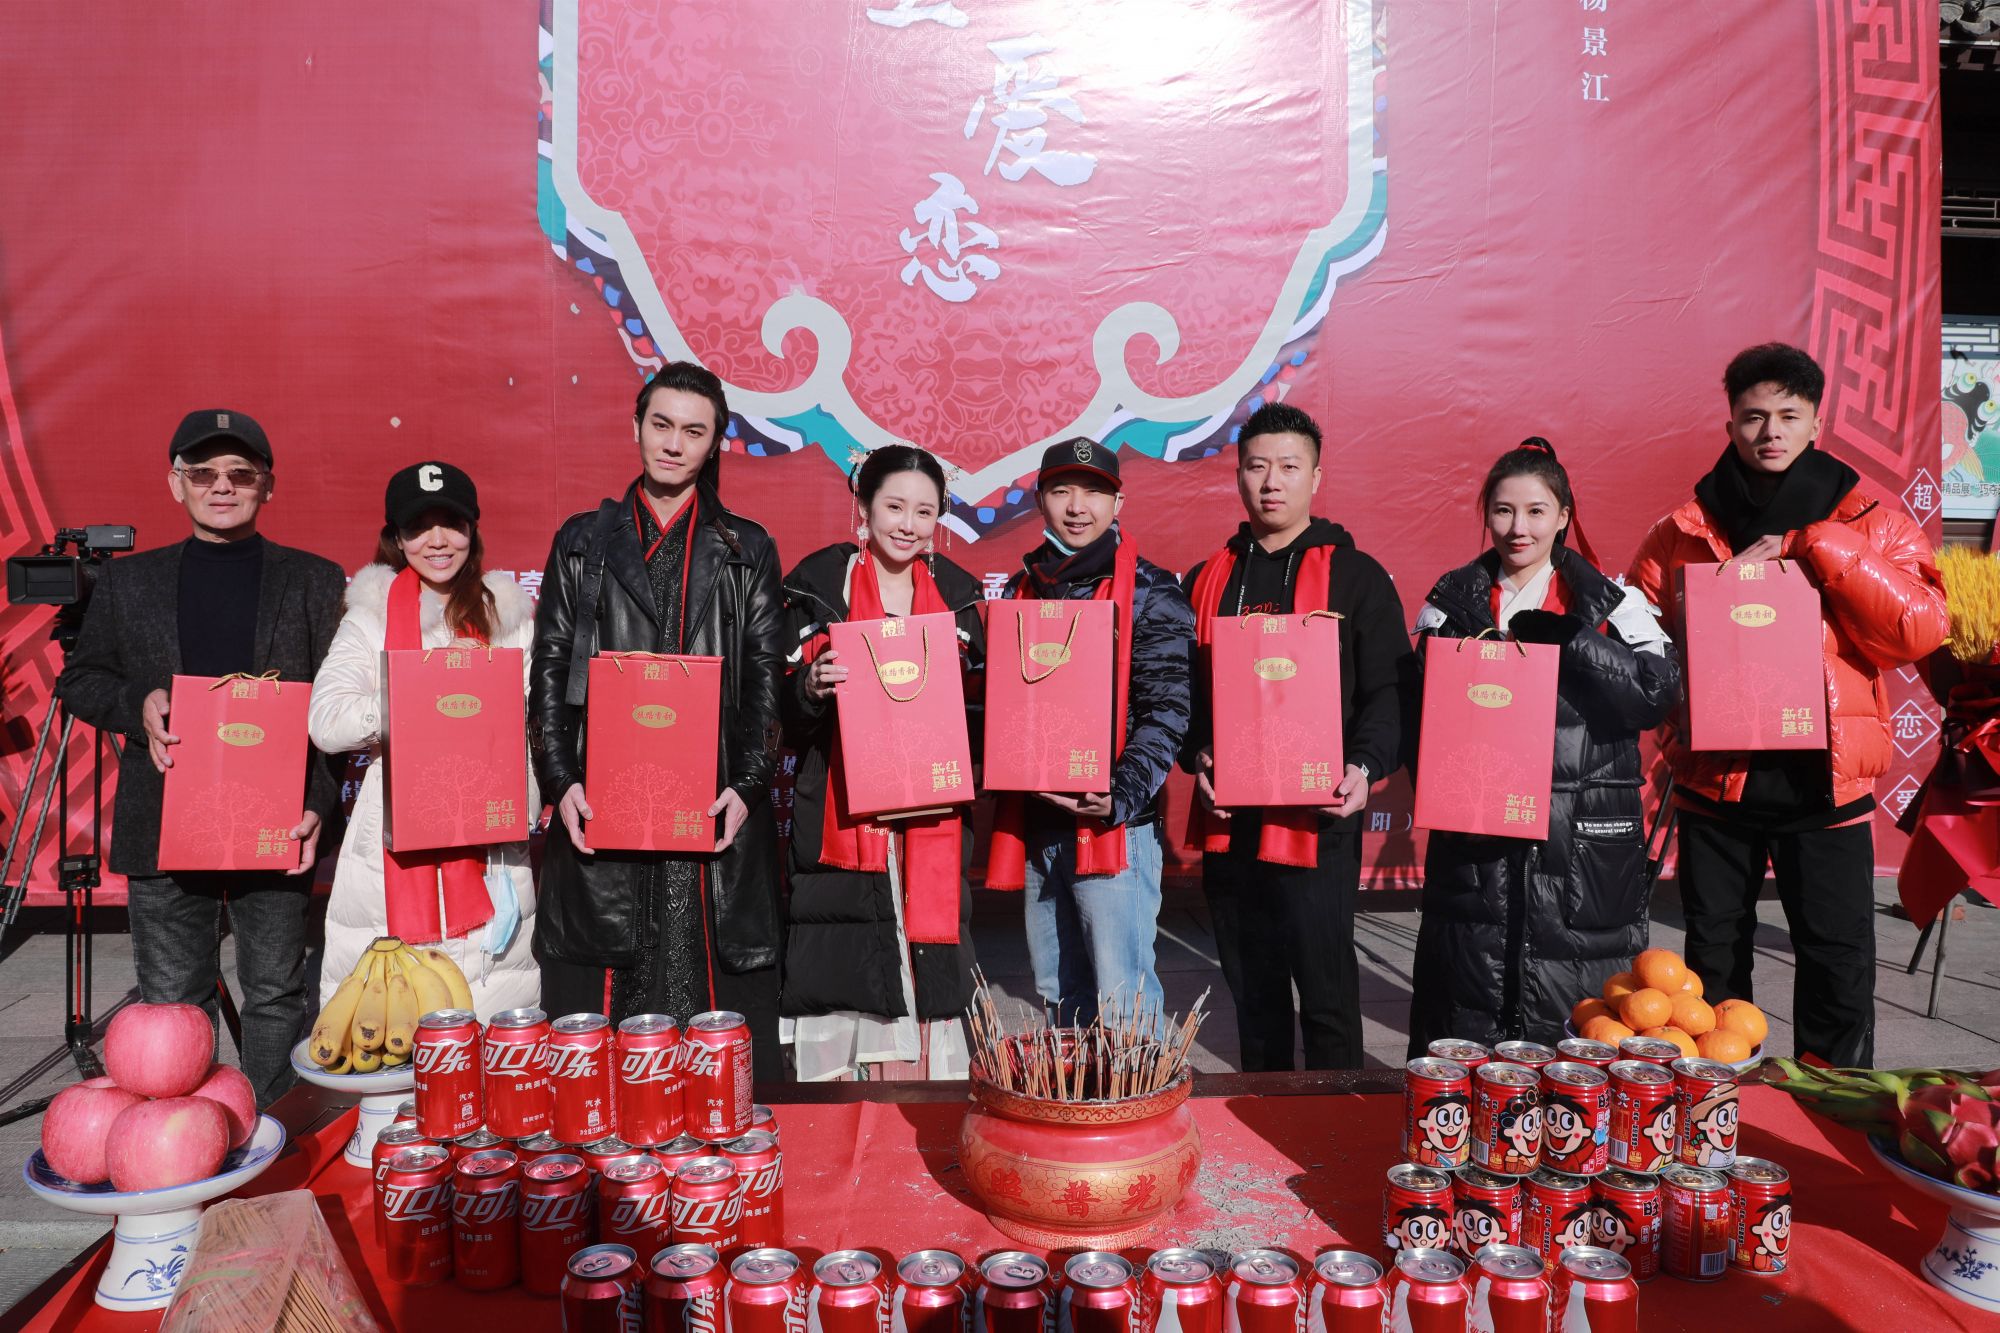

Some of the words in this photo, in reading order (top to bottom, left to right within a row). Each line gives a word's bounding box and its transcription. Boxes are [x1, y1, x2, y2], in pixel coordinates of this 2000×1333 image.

[418, 464, 444, 492] C
[1913, 483, 1933, 510] 超
[1896, 712, 1923, 739] 恋
